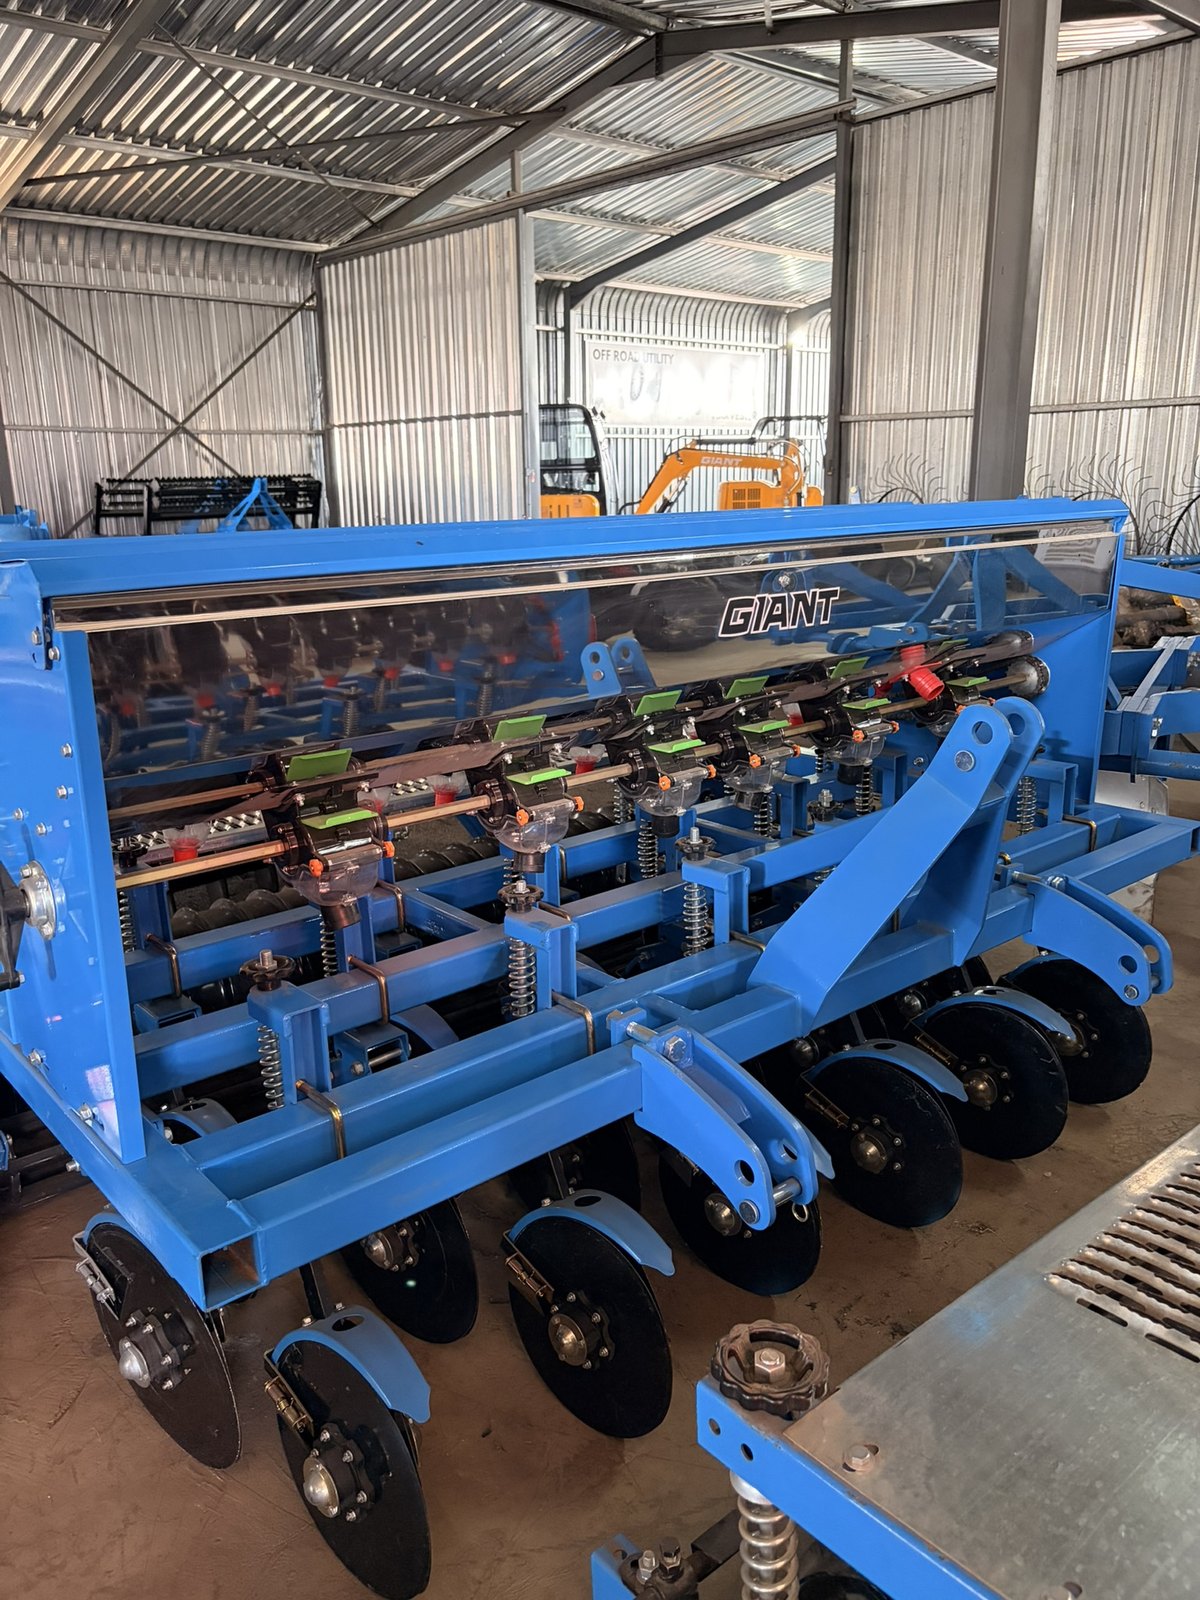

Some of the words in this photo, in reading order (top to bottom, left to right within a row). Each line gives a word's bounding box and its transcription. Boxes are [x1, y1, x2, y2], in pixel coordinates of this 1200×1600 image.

[593, 348, 612, 361] OFF
[643, 351, 675, 365] UTILITY
[700, 456, 743, 466] GIANT
[718, 587, 841, 637] GIANT
